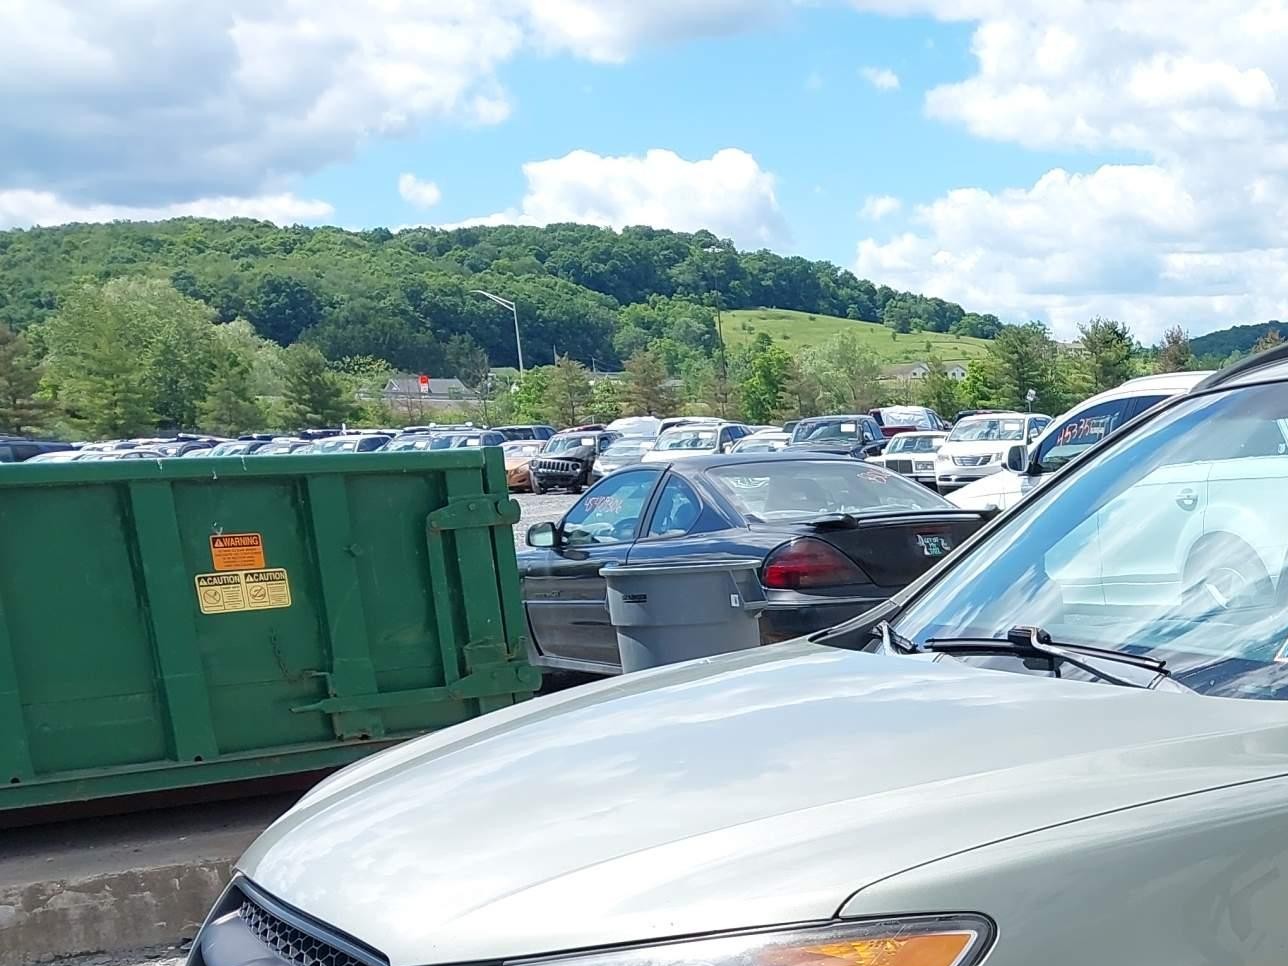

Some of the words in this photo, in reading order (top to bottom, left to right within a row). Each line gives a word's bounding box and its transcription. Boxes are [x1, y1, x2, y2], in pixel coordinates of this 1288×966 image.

[223, 536, 259, 547] WARNING
[206, 575, 240, 585] CAUTION
[253, 571, 286, 582] CAUTION
